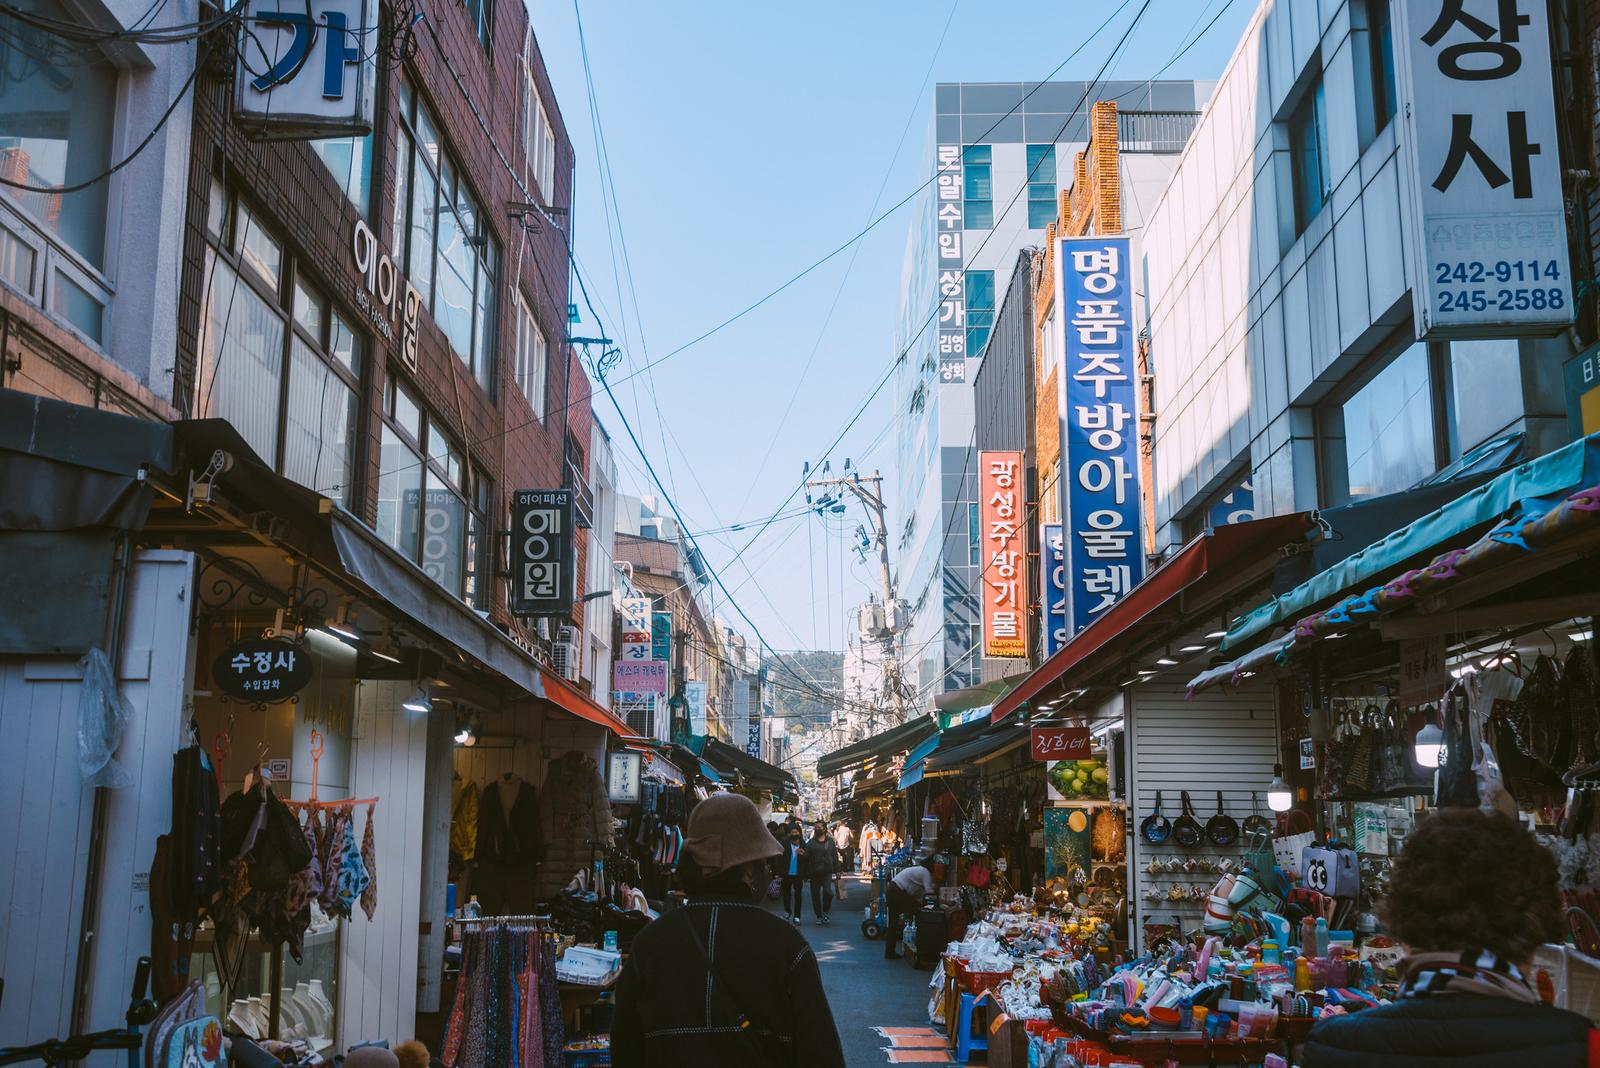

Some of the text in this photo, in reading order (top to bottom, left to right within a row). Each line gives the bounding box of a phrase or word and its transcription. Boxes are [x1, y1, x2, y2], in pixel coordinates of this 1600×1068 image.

[251, 11, 359, 97] 가
[1435, 259, 1560, 284] 242-9114
[1437, 288, 1565, 313] 245-2588
[1071, 247, 1134, 615] 명품주방아울렛
[520, 494, 567, 505] 하이패션
[989, 460, 1020, 638] 광성주방기물
[231, 650, 296, 674] 수정사
[1036, 733, 1087, 753] 진희네
